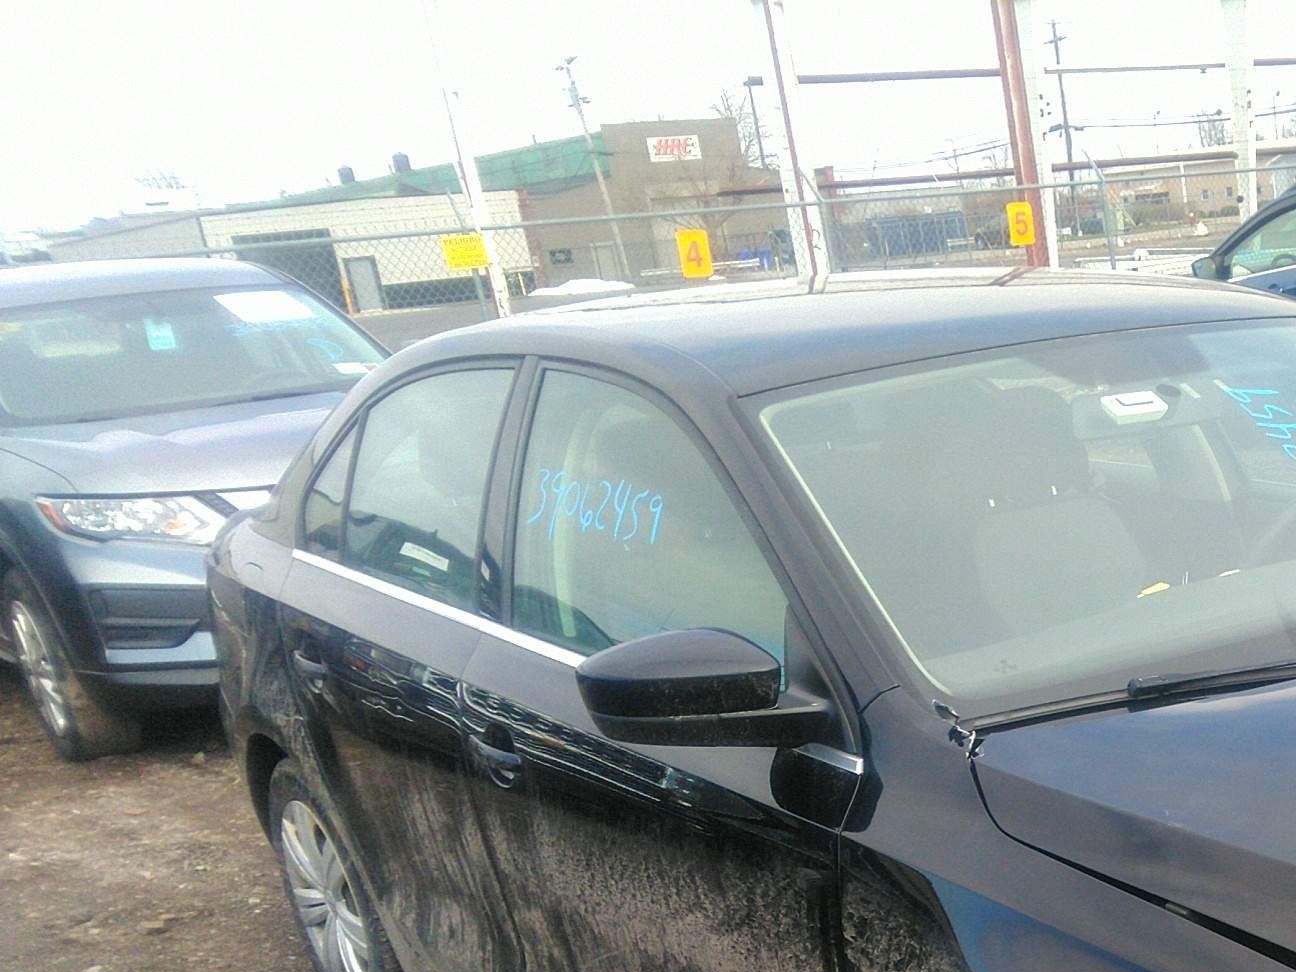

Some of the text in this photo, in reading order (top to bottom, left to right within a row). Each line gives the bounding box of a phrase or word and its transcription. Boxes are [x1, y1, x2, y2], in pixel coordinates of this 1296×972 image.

[1015, 210, 1029, 237] 5
[686, 239, 704, 268] 4
[528, 467, 664, 545] 39062459
